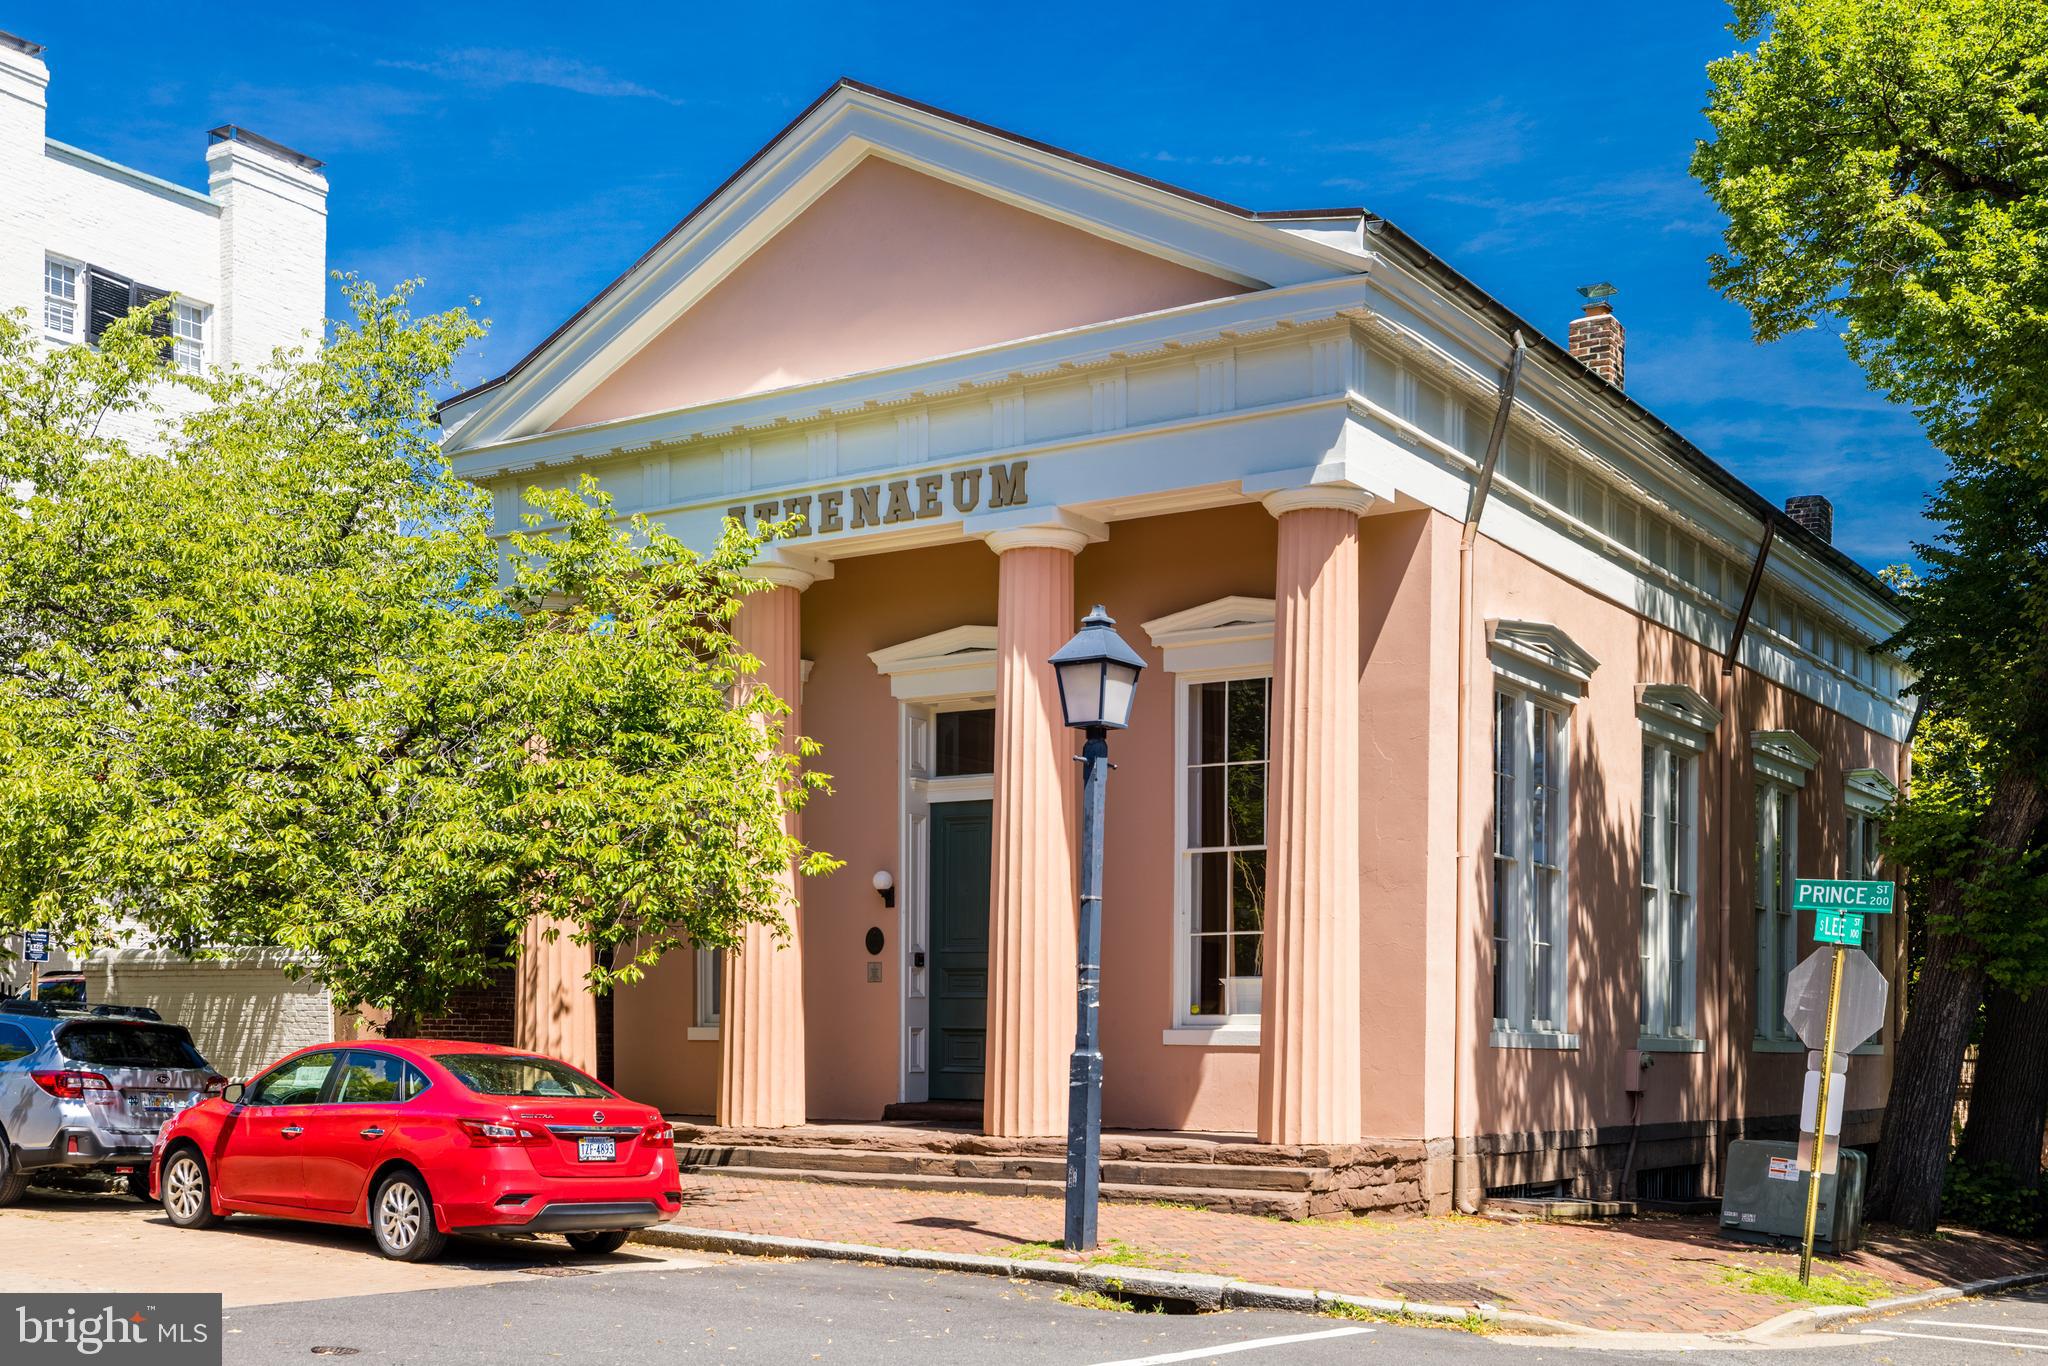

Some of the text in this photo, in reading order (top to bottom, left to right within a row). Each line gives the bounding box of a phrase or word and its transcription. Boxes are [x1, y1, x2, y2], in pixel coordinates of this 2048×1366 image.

[1799, 884, 1890, 905] PRINCE ST
[1870, 896, 1890, 906] 200
[1819, 917, 1861, 937] S LEE ST
[1850, 929, 1859, 938] 100
